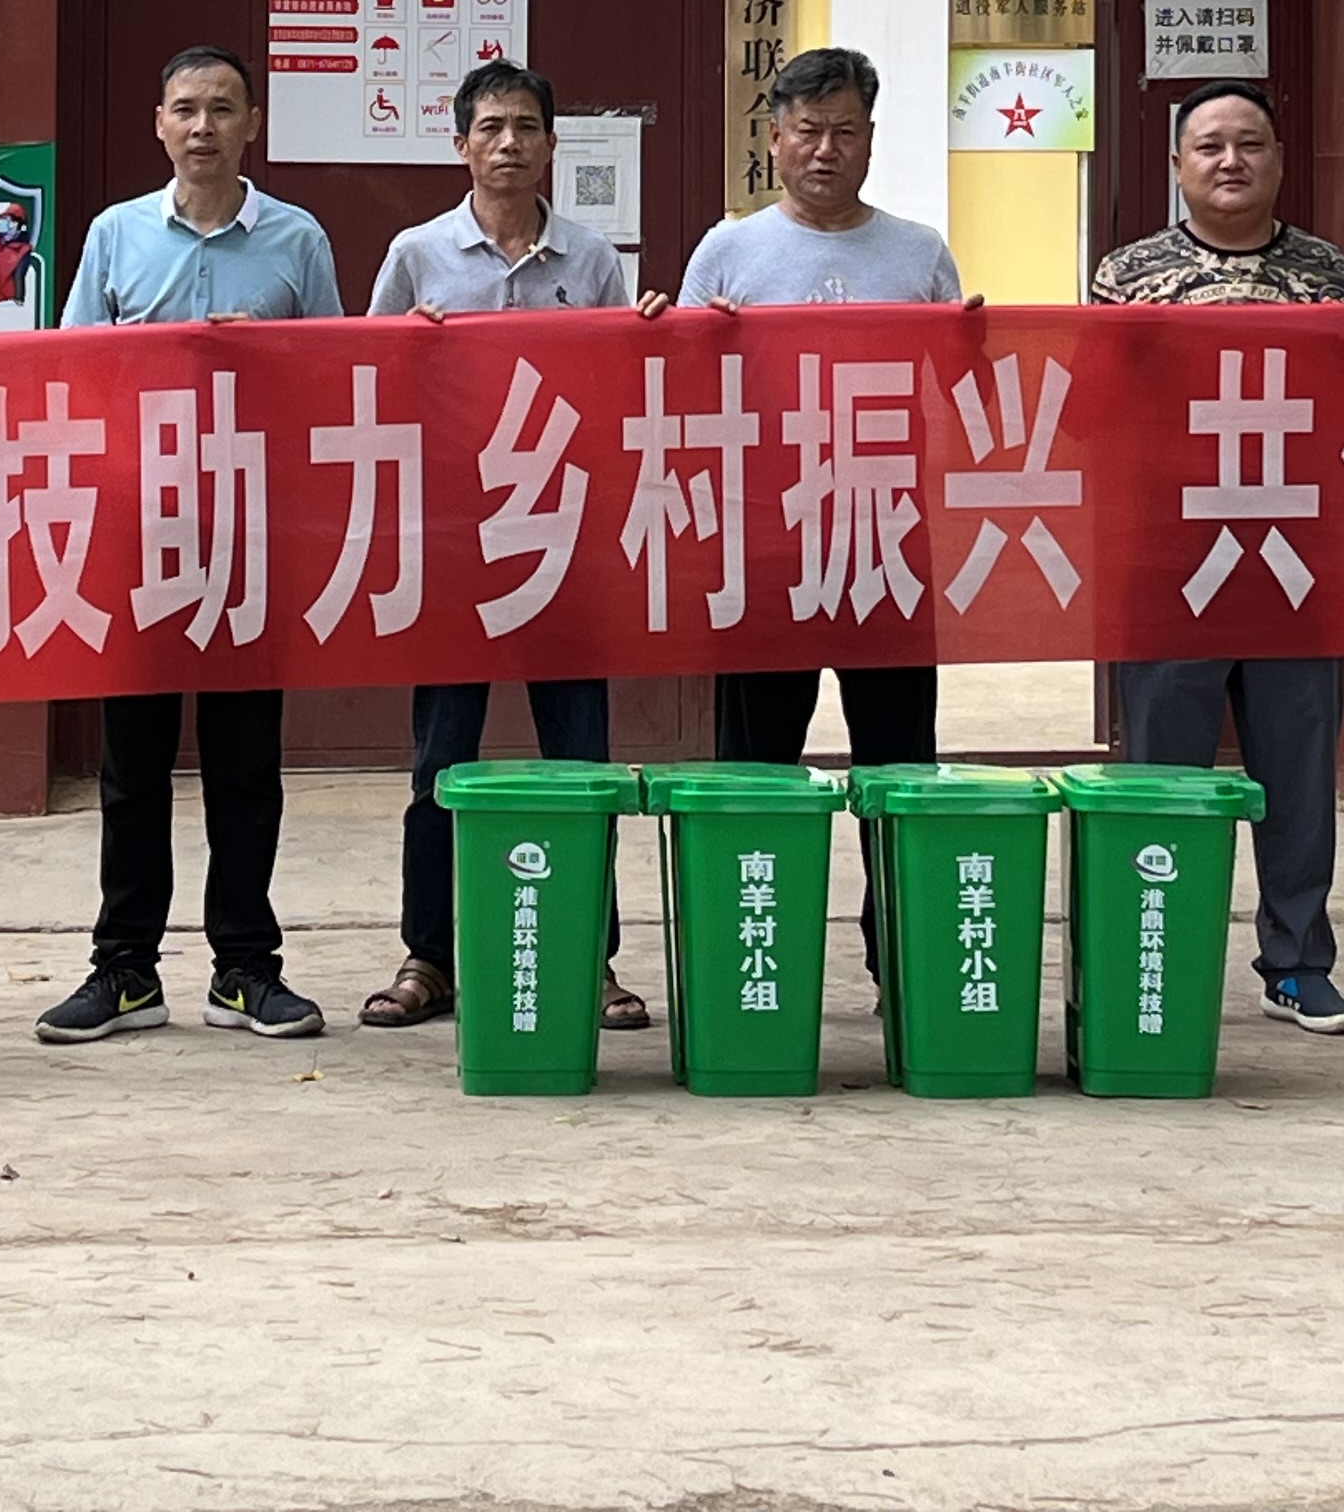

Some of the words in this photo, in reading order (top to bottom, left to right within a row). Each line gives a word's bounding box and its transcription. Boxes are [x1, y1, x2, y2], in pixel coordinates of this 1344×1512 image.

[1154, 7, 1255, 27] 进入请扫码
[1155, 34, 1258, 55] 并佩戴口罩
[513, 886, 538, 1033] 淮鼎环境科技赠
[738, 850, 780, 1013] 南羊村小组
[956, 852, 1000, 1014] 南羊村小组
[1138, 889, 1165, 1035] 淮鼎环境科技赠
